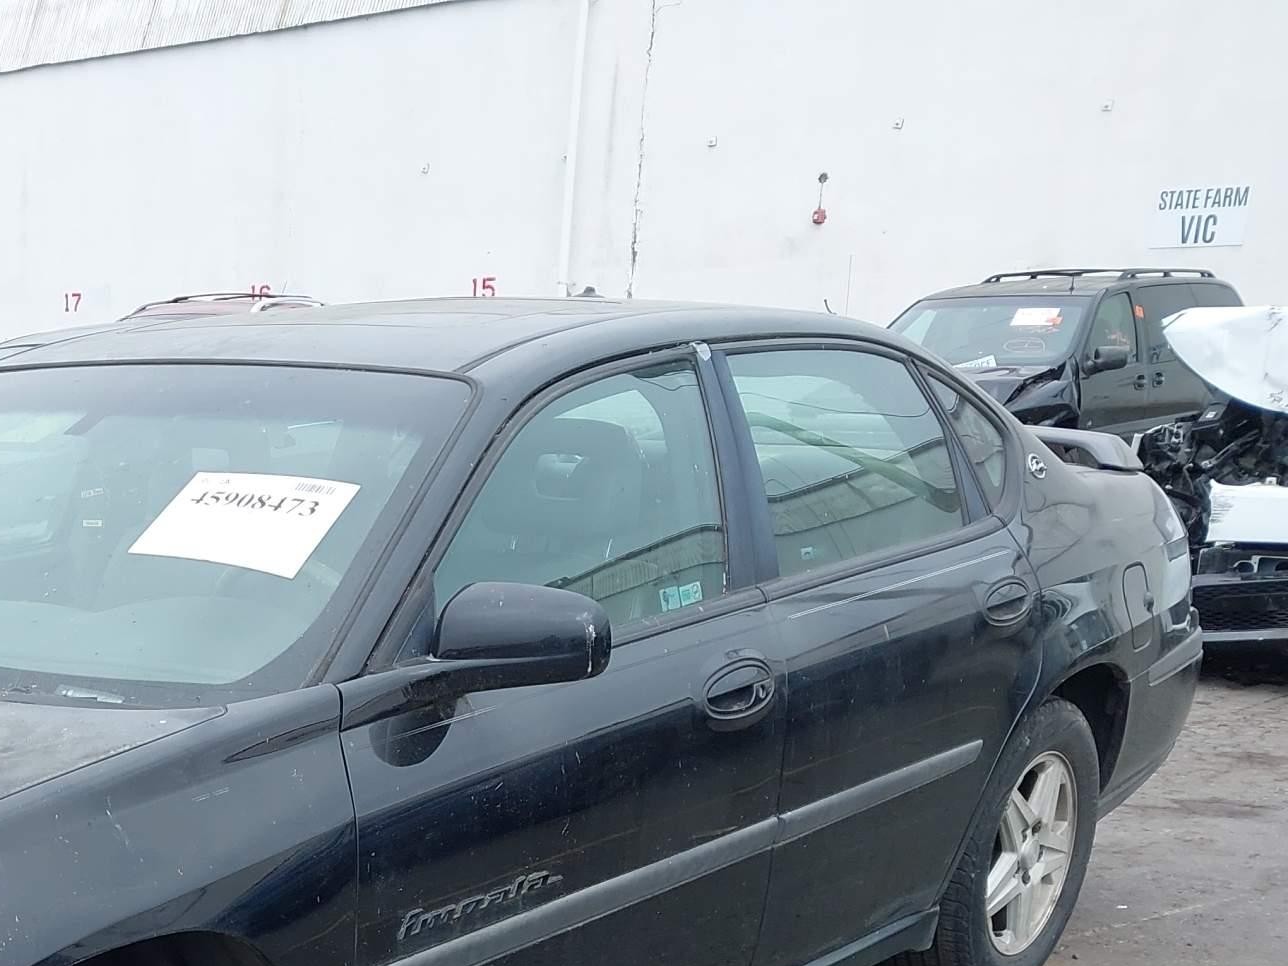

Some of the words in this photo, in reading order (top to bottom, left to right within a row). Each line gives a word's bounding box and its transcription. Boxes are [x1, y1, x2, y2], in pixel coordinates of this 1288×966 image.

[1158, 188, 1201, 211] STATE
[1203, 186, 1250, 208] FARM
[1181, 213, 1217, 244] VIC
[472, 276, 496, 297] 15
[64, 293, 82, 312] 17
[190, 490, 320, 516] 45908473
[396, 870, 563, 940] Impala
